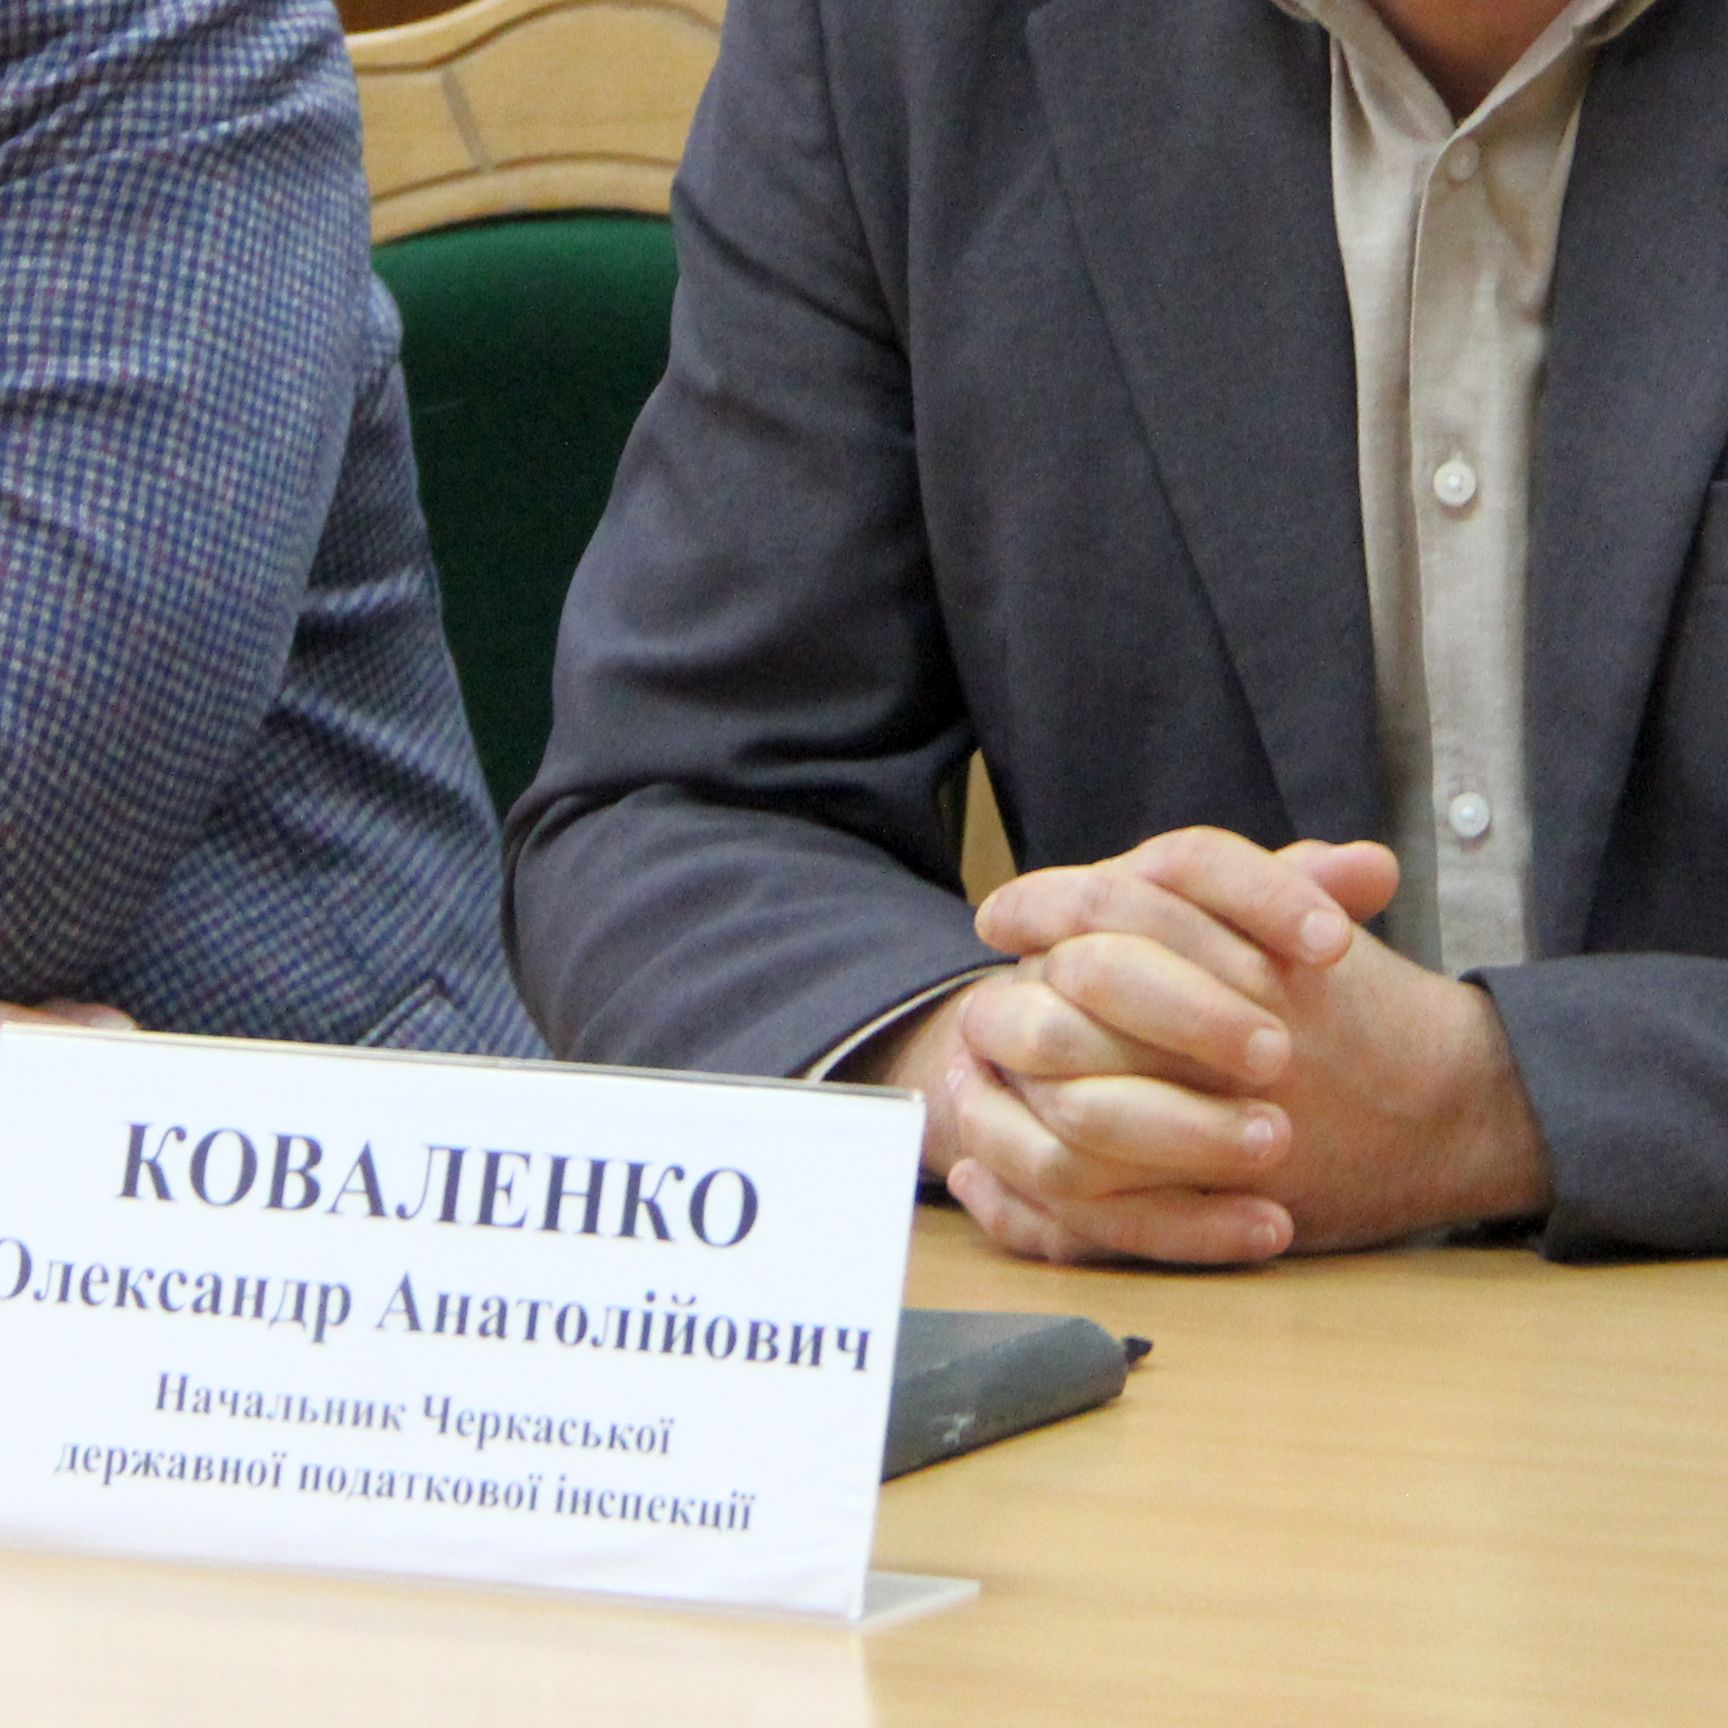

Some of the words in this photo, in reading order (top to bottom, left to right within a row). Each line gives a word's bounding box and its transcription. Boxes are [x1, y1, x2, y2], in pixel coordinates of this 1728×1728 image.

[117, 1122, 760, 1249] КОВАЛЕНКО
[375, 1271, 872, 1372] Анатолійович
[154, 1371, 407, 1432] Начальник
[422, 1394, 675, 1456] Черкаської
[54, 1443, 287, 1489] державної
[297, 1463, 543, 1512] податкової
[554, 1473, 757, 1532] інспекції
